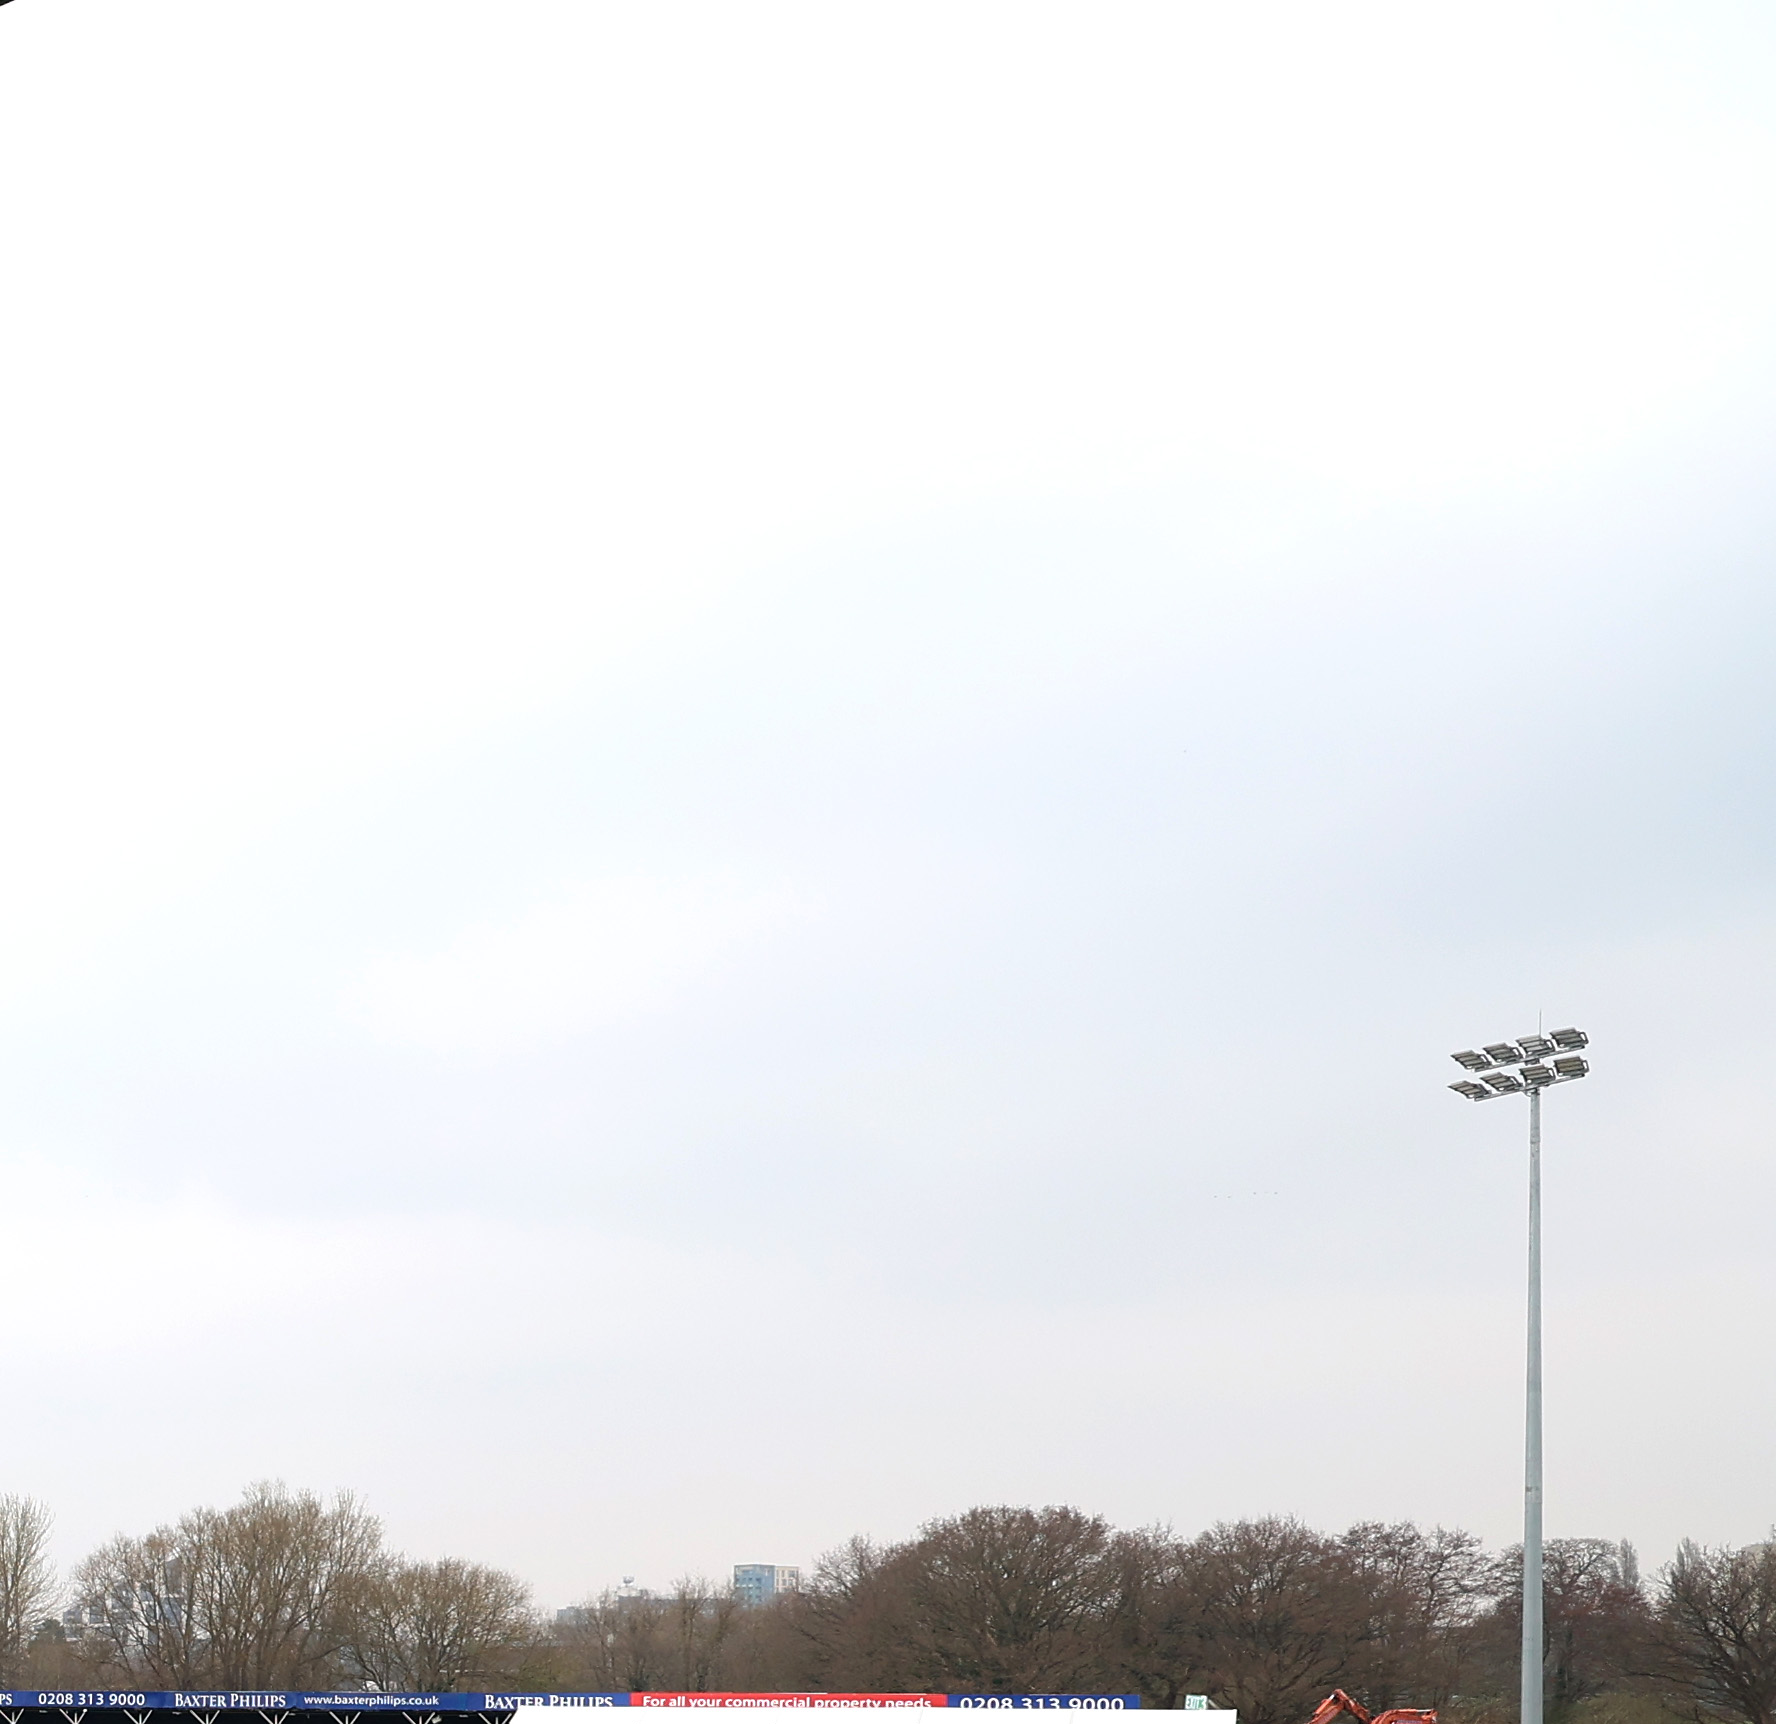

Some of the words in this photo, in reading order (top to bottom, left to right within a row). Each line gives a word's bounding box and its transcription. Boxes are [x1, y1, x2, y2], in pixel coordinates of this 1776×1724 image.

[38, 1692, 74, 1706] 0208
[77, 1693, 104, 1706] 313
[108, 1693, 146, 1707] 9000
[174, 1692, 227, 1708] BAXTER
[229, 1692, 286, 1708] PHILIPS
[304, 1694, 440, 1707] www.baxterphilips.co.uk
[642, 1695, 670, 1707] For
[960, 1696, 1014, 1710] 0208
[1070, 1697, 1125, 1710] 9000
